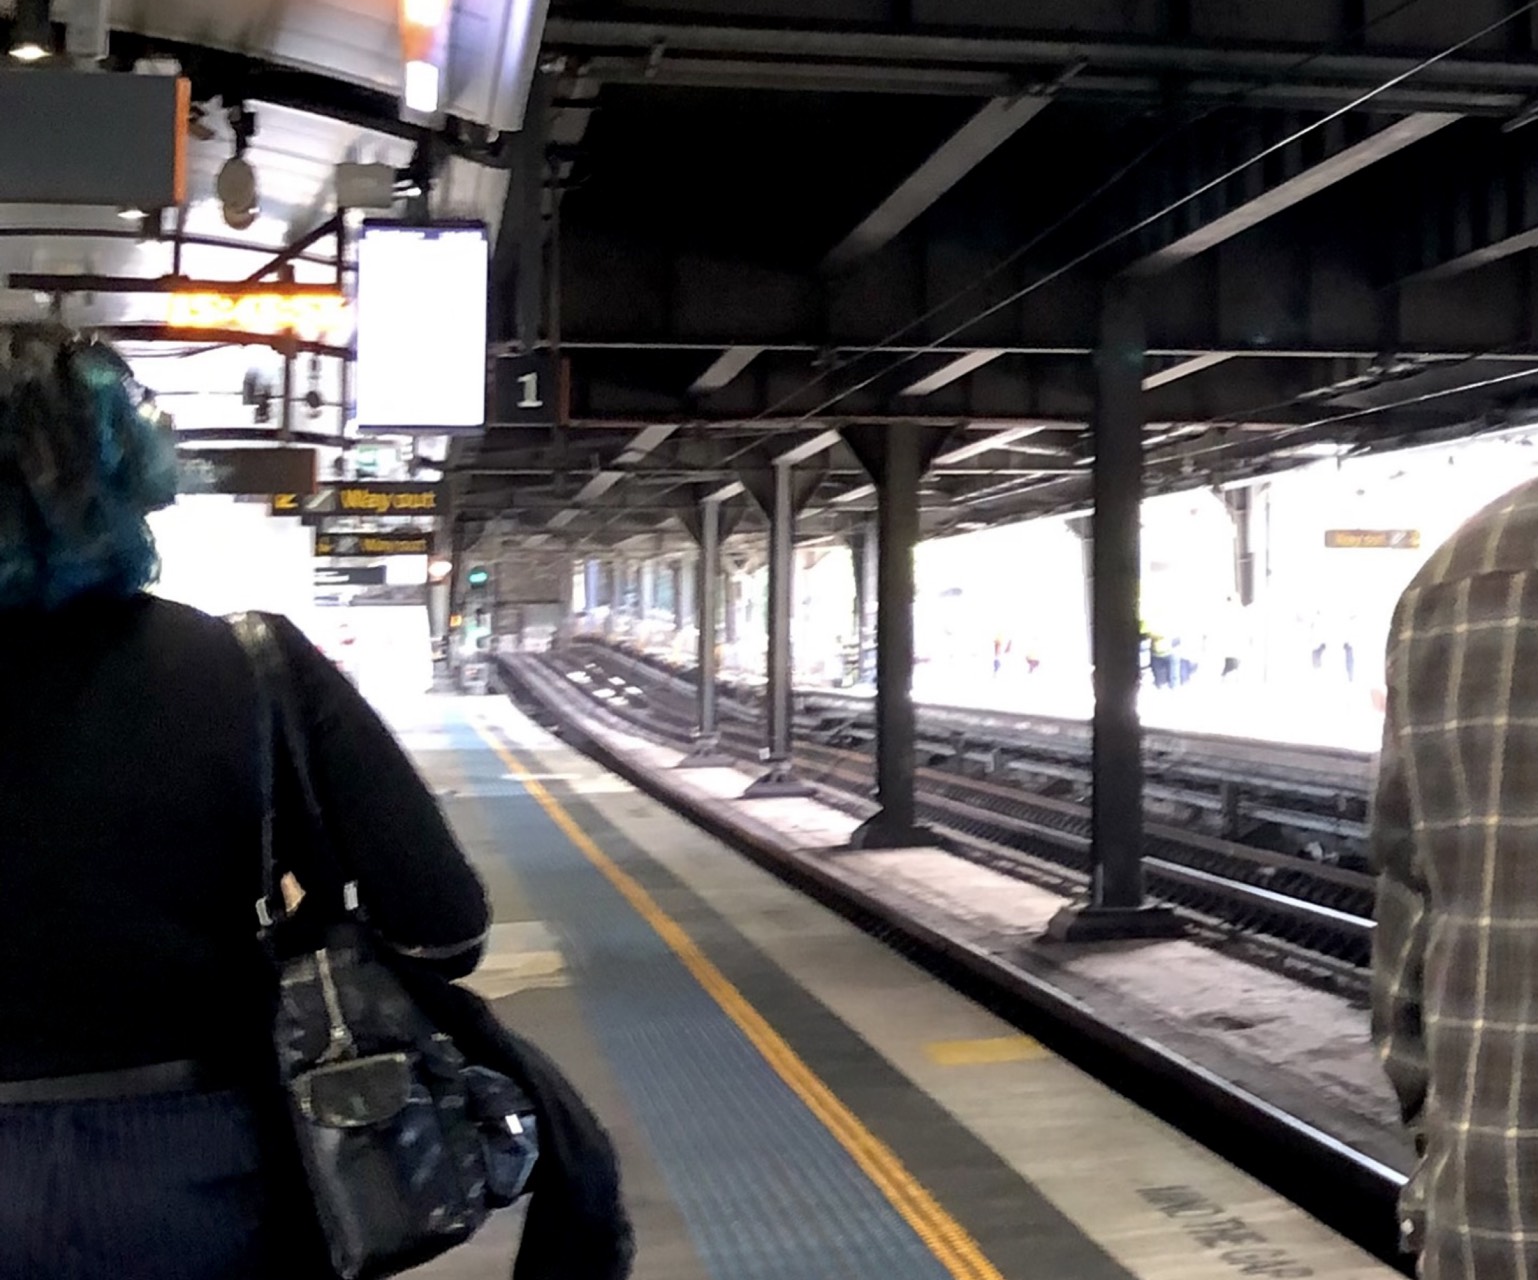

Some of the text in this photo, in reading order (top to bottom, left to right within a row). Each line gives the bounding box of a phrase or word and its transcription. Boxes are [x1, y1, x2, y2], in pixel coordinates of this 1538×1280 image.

[517, 372, 543, 408] 1
[340, 489, 436, 512] Way out
[1219, 1248, 1314, 1278] GAP
